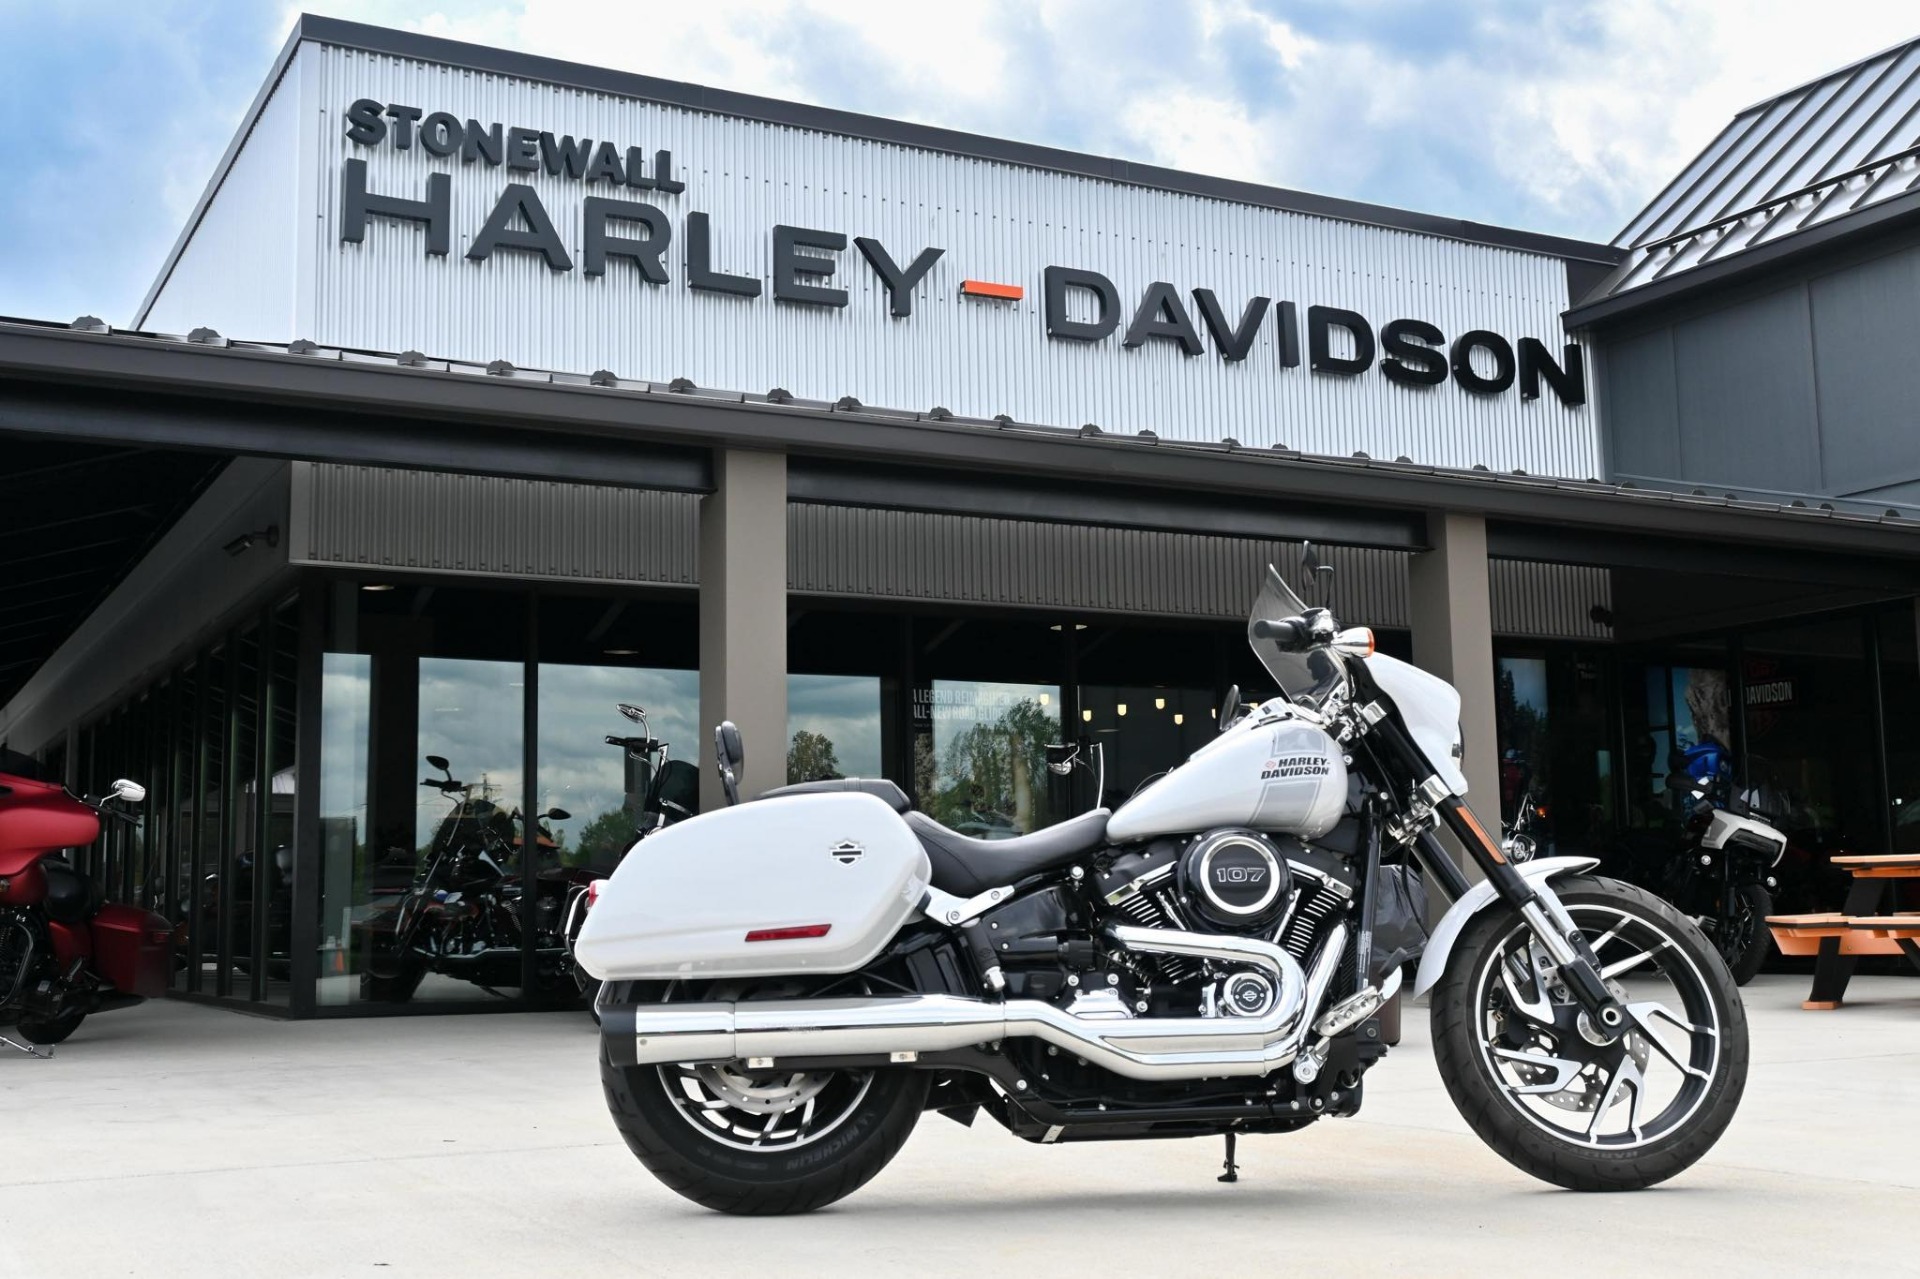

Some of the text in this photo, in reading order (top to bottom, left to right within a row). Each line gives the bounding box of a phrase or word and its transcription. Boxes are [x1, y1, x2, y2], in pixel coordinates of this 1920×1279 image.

[346, 98, 685, 194] STONEWALL
[919, 689, 953, 704] LEGEND
[1261, 766, 1330, 780] DAVIDSON
[1216, 867, 1266, 883] 107
